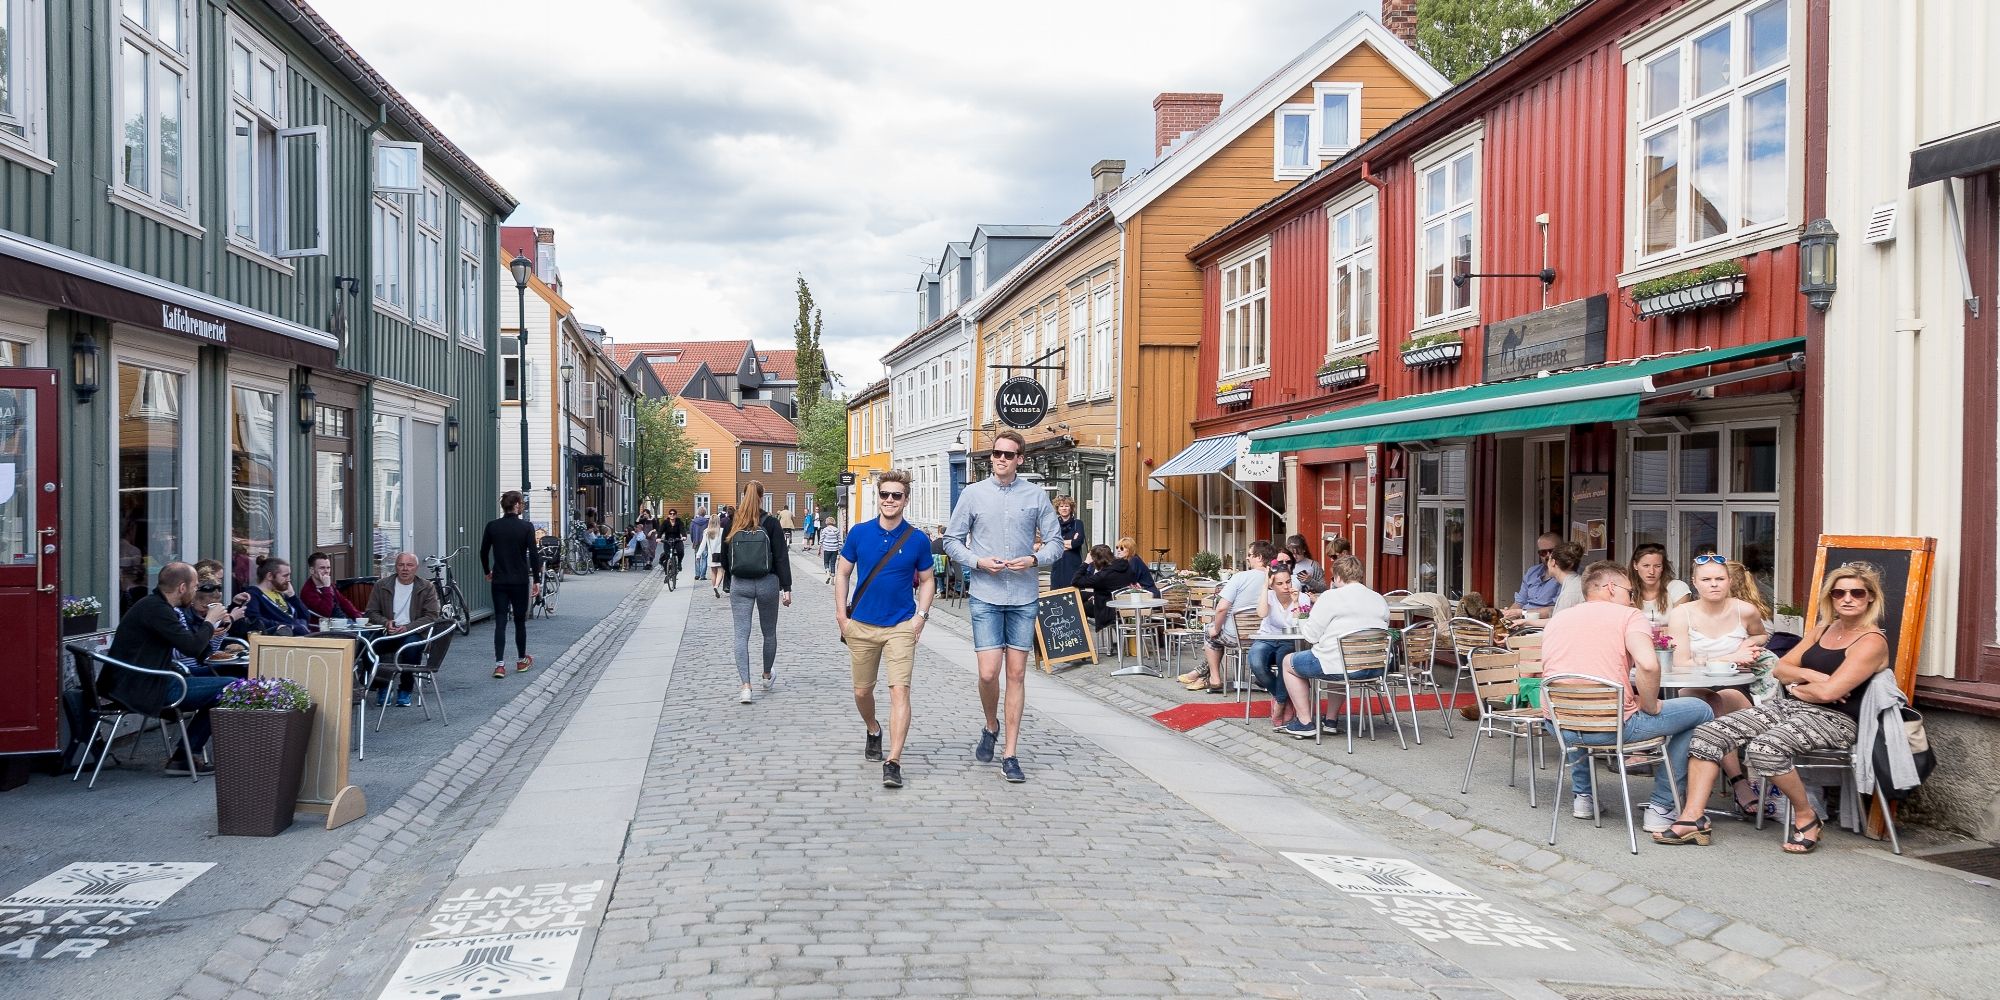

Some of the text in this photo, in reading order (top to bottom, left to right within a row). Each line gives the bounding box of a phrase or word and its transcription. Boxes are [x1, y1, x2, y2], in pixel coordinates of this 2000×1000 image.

[162, 304, 226, 342] Kaffebrenneriet
[1517, 349, 1567, 371] KAFFEBAR
[1003, 393, 1040, 405] KALAS
[446, 880, 604, 902] PENT
[429, 902, 593, 922] FOR AT DU
[438, 893, 598, 912] SYKLER
[1349, 893, 1516, 915] TAKK
[420, 912, 586, 938] TAKK
[1371, 907, 1438, 919] FOR
[1447, 912, 1483, 922] AT
[26, 925, 81, 934] AT
[81, 926, 132, 935] DU
[1390, 916, 1560, 936] SYKLER
[0, 935, 109, 959] ÅR
[1408, 927, 1577, 951] PENT
